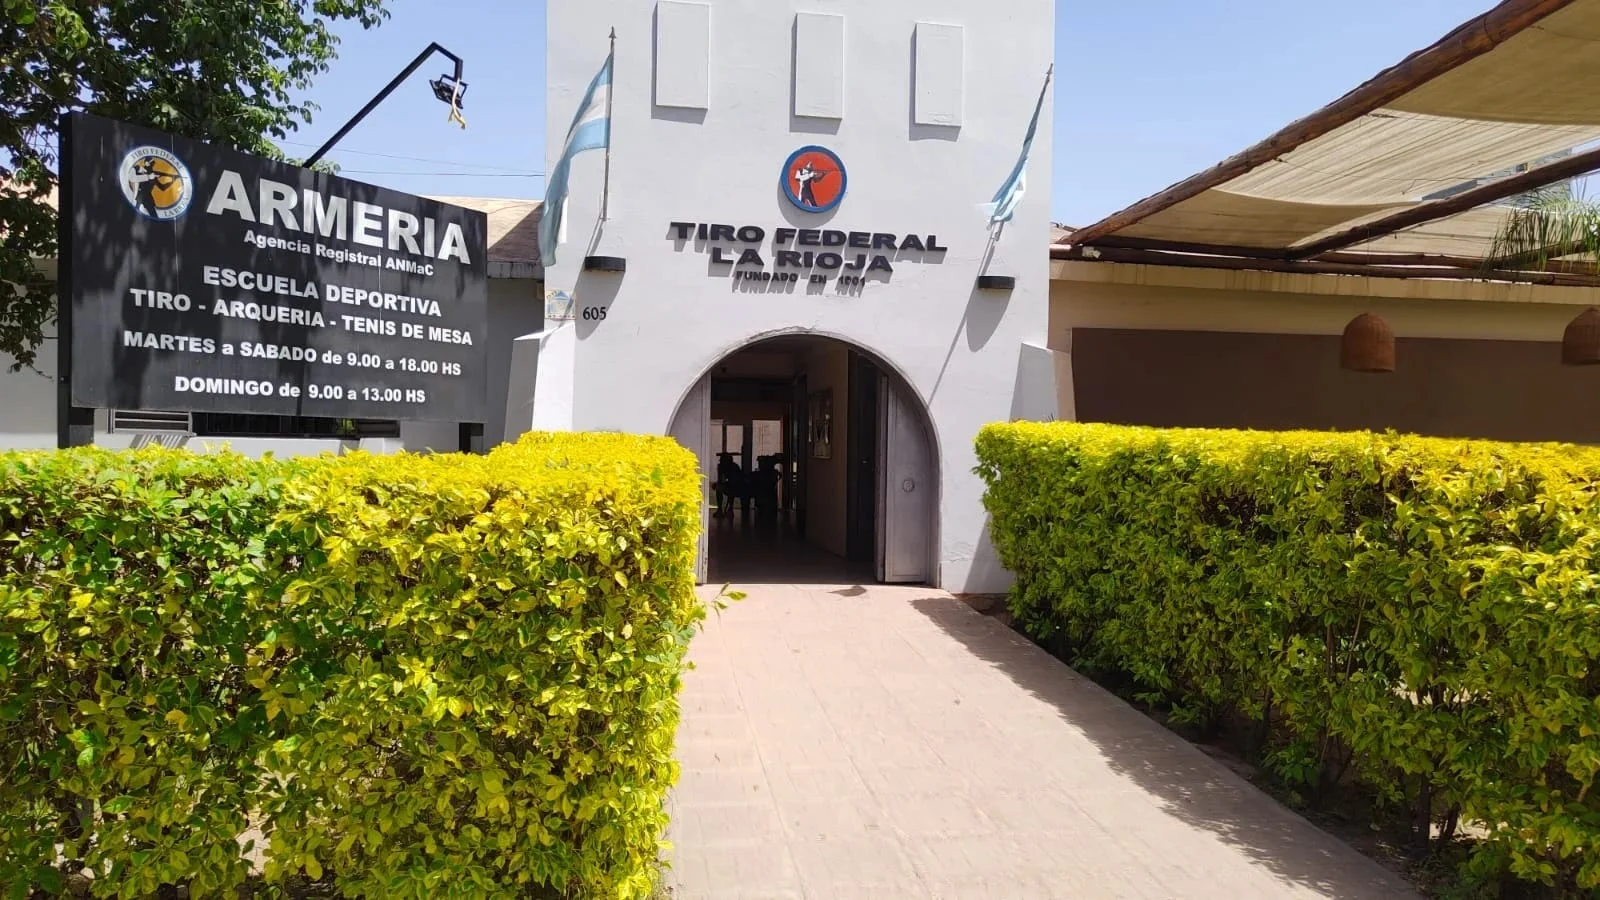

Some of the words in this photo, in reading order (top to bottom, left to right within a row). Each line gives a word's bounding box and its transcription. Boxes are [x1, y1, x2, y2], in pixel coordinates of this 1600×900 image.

[206, 170, 471, 265] ARMERIA
[670, 221, 765, 242] TIRO
[776, 227, 948, 251] FEDERAL
[244, 229, 312, 255] Agencia
[316, 242, 382, 267] Registral
[385, 256, 434, 276] ANMaC
[712, 248, 764, 266] LA
[777, 251, 893, 272] RIOJA
[204, 266, 319, 299] ESCUELA
[326, 284, 441, 317] DEPORTIVA
[736, 271, 799, 282] FUNDADO
[810, 275, 827, 283] EN
[130, 288, 191, 312] TIRO
[213, 299, 324, 327] ARQUERIA
[342, 315, 396, 336] TENIS
[402, 323, 423, 339] DE
[429, 327, 473, 345] MESA
[583, 307, 606, 320] 605
[124, 331, 215, 354] MARTES
[222, 343, 234, 355] a
[240, 342, 317, 363] SABADO
[322, 350, 342, 365] de
[347, 353, 380, 369] 9.00
[385, 359, 395, 370] a
[399, 358, 438, 374] 18.00
[442, 362, 461, 375] HS
[175, 376, 274, 397] DOMINGO
[279, 381, 301, 398] de
[309, 384, 342, 400] 9.00
[348, 389, 357, 400] a
[362, 387, 402, 402] 13.00
[406, 389, 425, 403] HS
